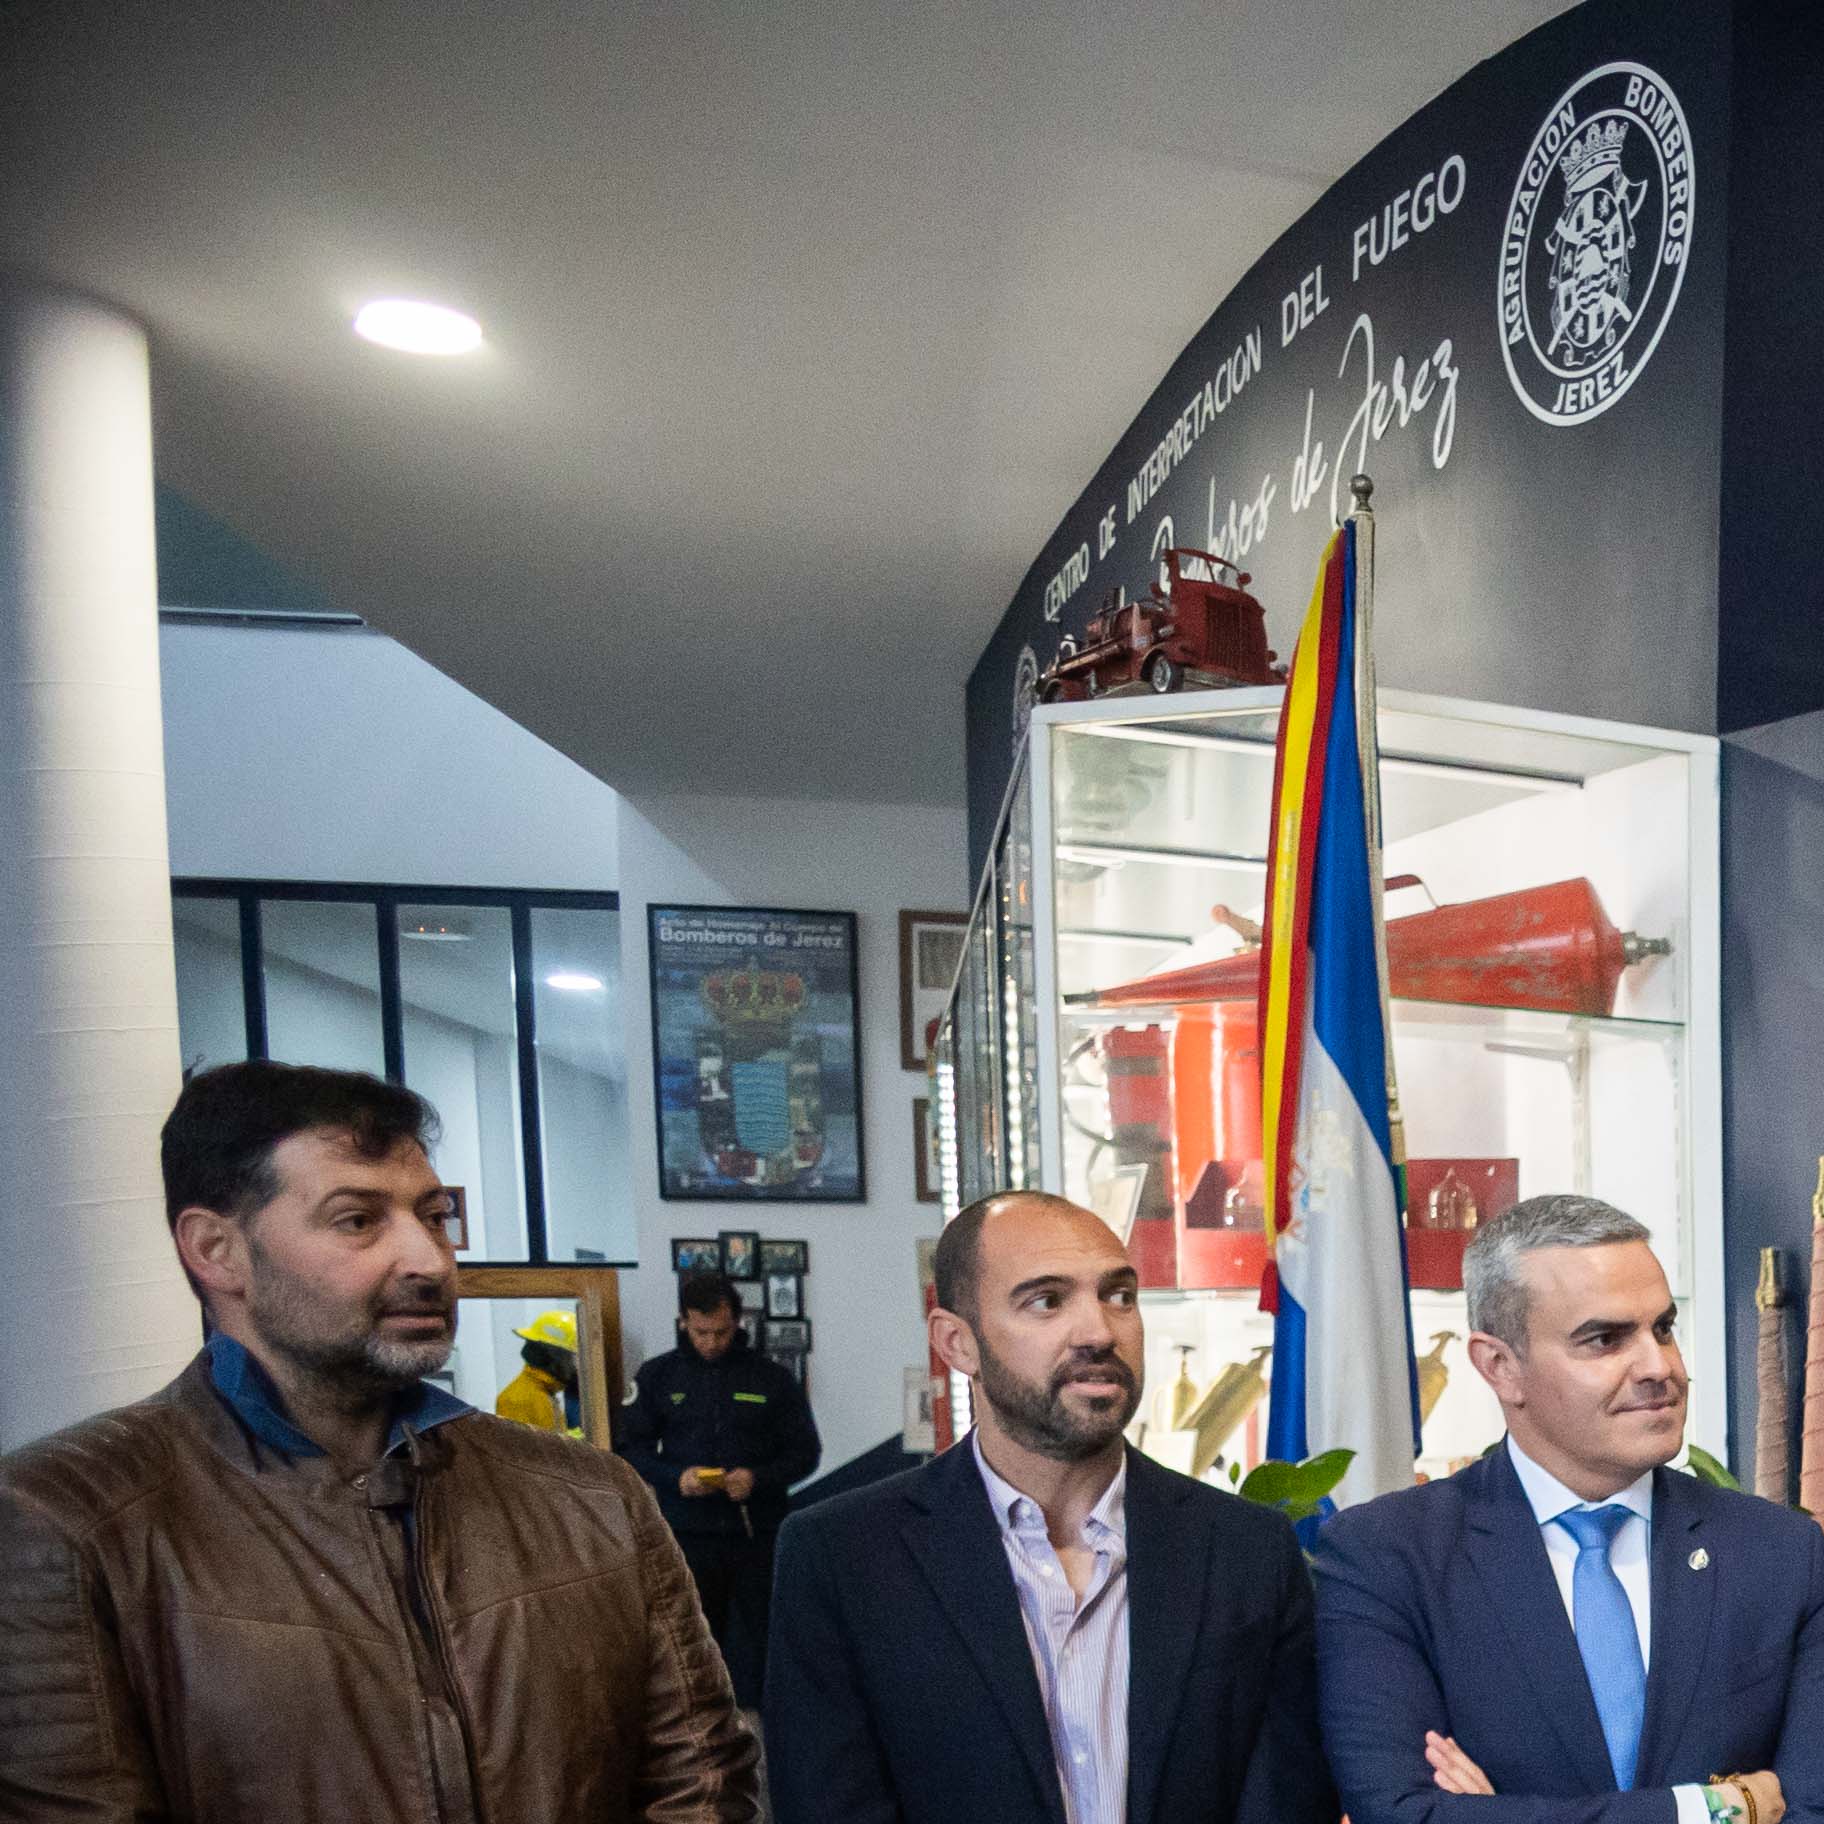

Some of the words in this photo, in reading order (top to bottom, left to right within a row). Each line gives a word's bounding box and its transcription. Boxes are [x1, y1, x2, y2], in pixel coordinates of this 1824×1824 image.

[1504, 101, 1577, 345] AGRUPACION
[1624, 74, 1688, 266] BOMBEROS
[1044, 541, 1090, 623] CENTRO
[1099, 503, 1117, 561] DE
[1127, 324, 1262, 525] INTERPRETACION
[1281, 264, 1330, 348] DEL
[1351, 154, 1467, 282] FUEGO
[1290, 387, 1329, 514] de
[1330, 313, 1460, 531] Jerez
[1552, 351, 1629, 414] JEREZ
[660, 926, 758, 946] Bomberos
[763, 930, 788, 947] de
[792, 932, 844, 948] Jerez
